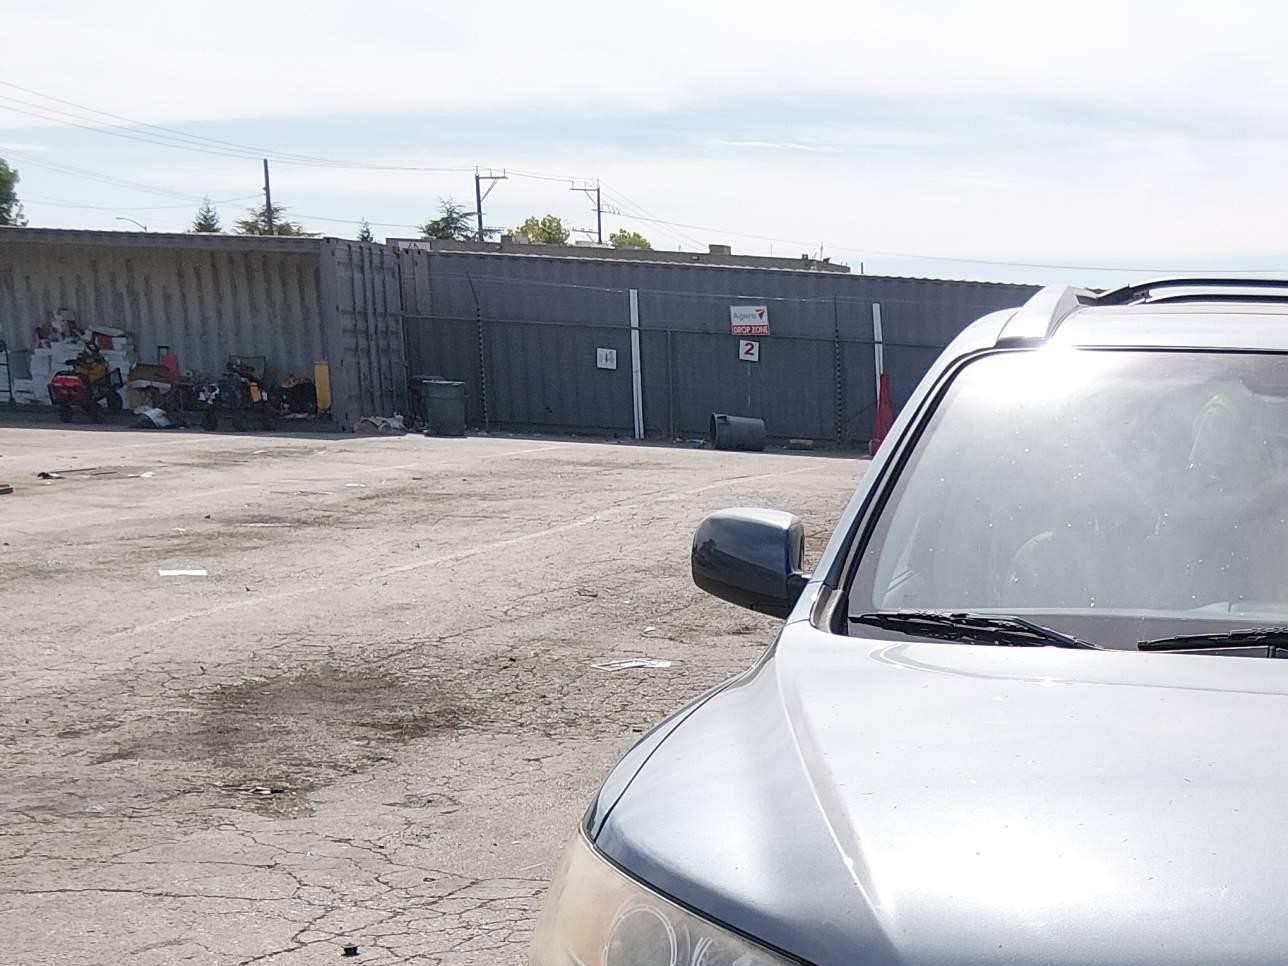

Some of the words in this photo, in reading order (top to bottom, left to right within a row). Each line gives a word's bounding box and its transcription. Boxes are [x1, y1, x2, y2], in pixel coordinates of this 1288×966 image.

[734, 326, 750, 334] DROP
[751, 326, 768, 334] ZONE
[744, 342, 754, 356] 2
